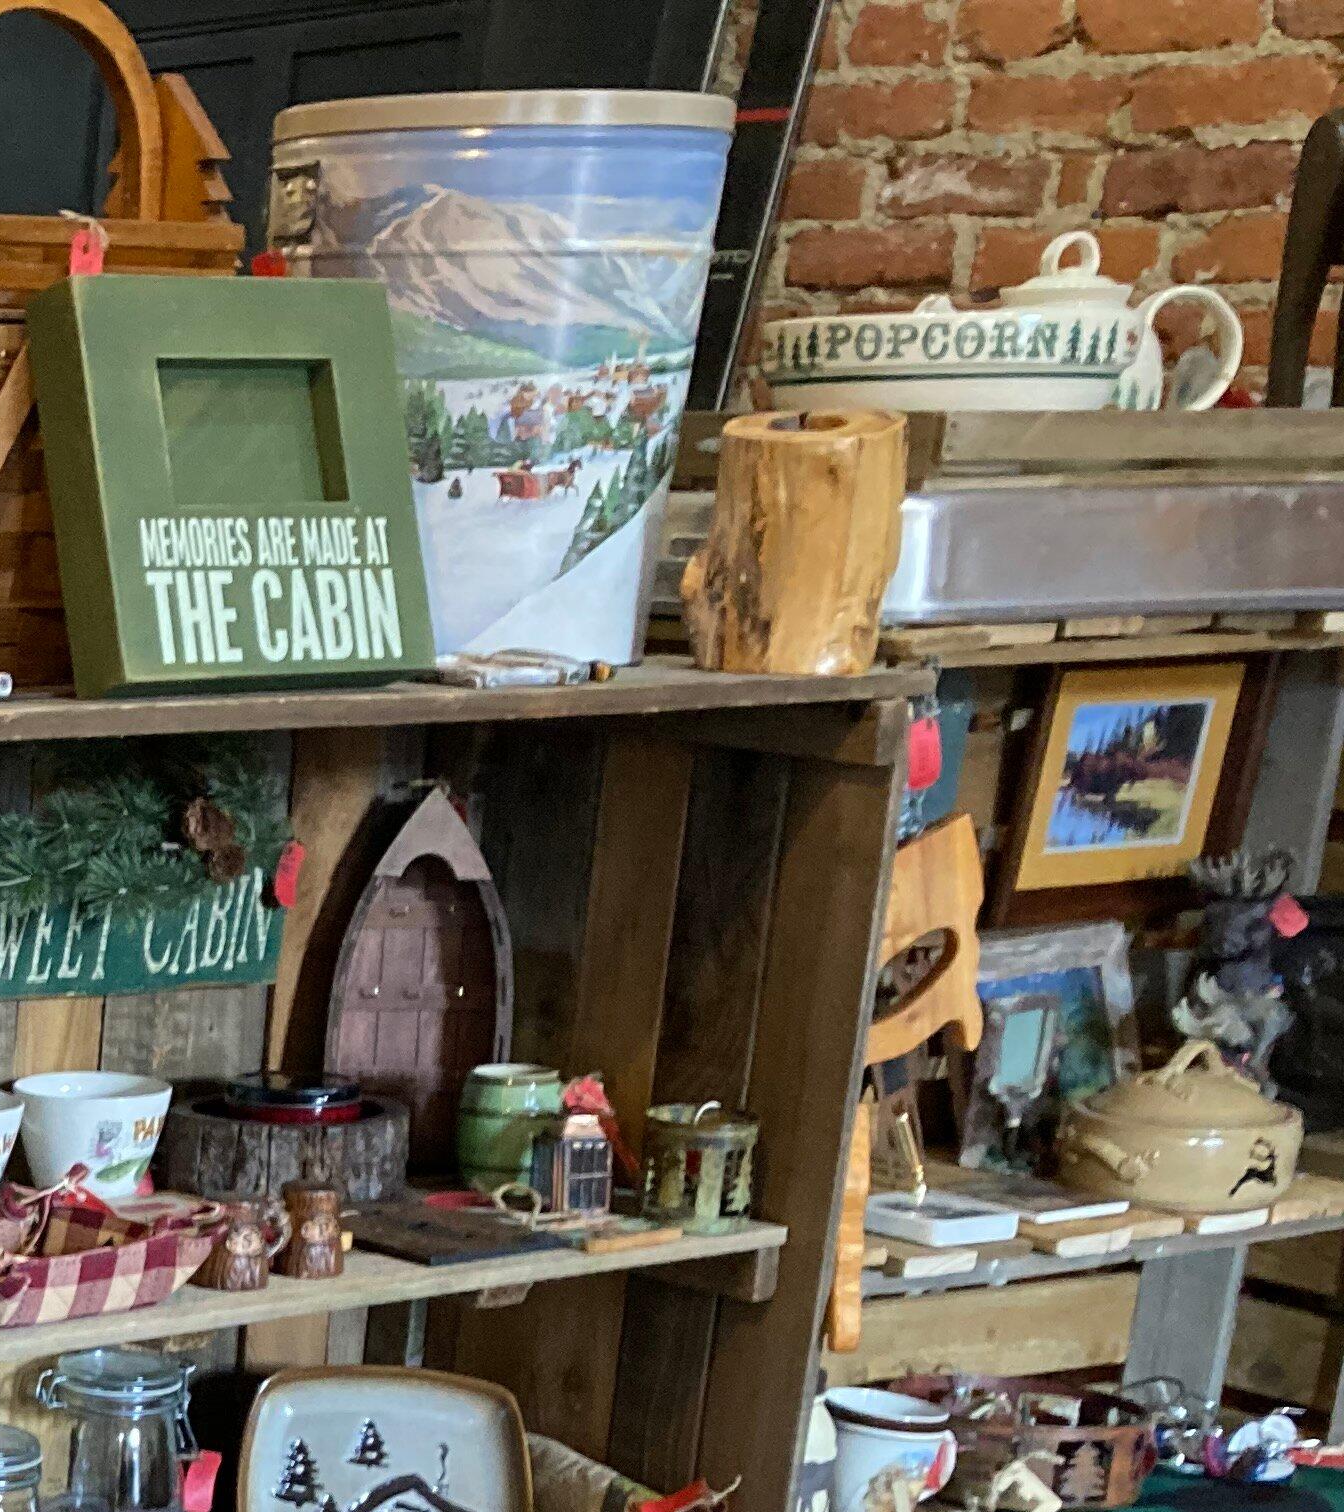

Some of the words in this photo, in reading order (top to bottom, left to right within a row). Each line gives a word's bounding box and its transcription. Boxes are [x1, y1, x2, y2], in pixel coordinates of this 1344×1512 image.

[824, 319, 1062, 361] POPCORN
[139, 517, 253, 568] MEMORIES
[257, 516, 299, 566] ARE
[300, 516, 362, 566] MADE
[365, 516, 390, 565] AT
[145, 569, 244, 665] THE
[250, 567, 404, 663] CABIN
